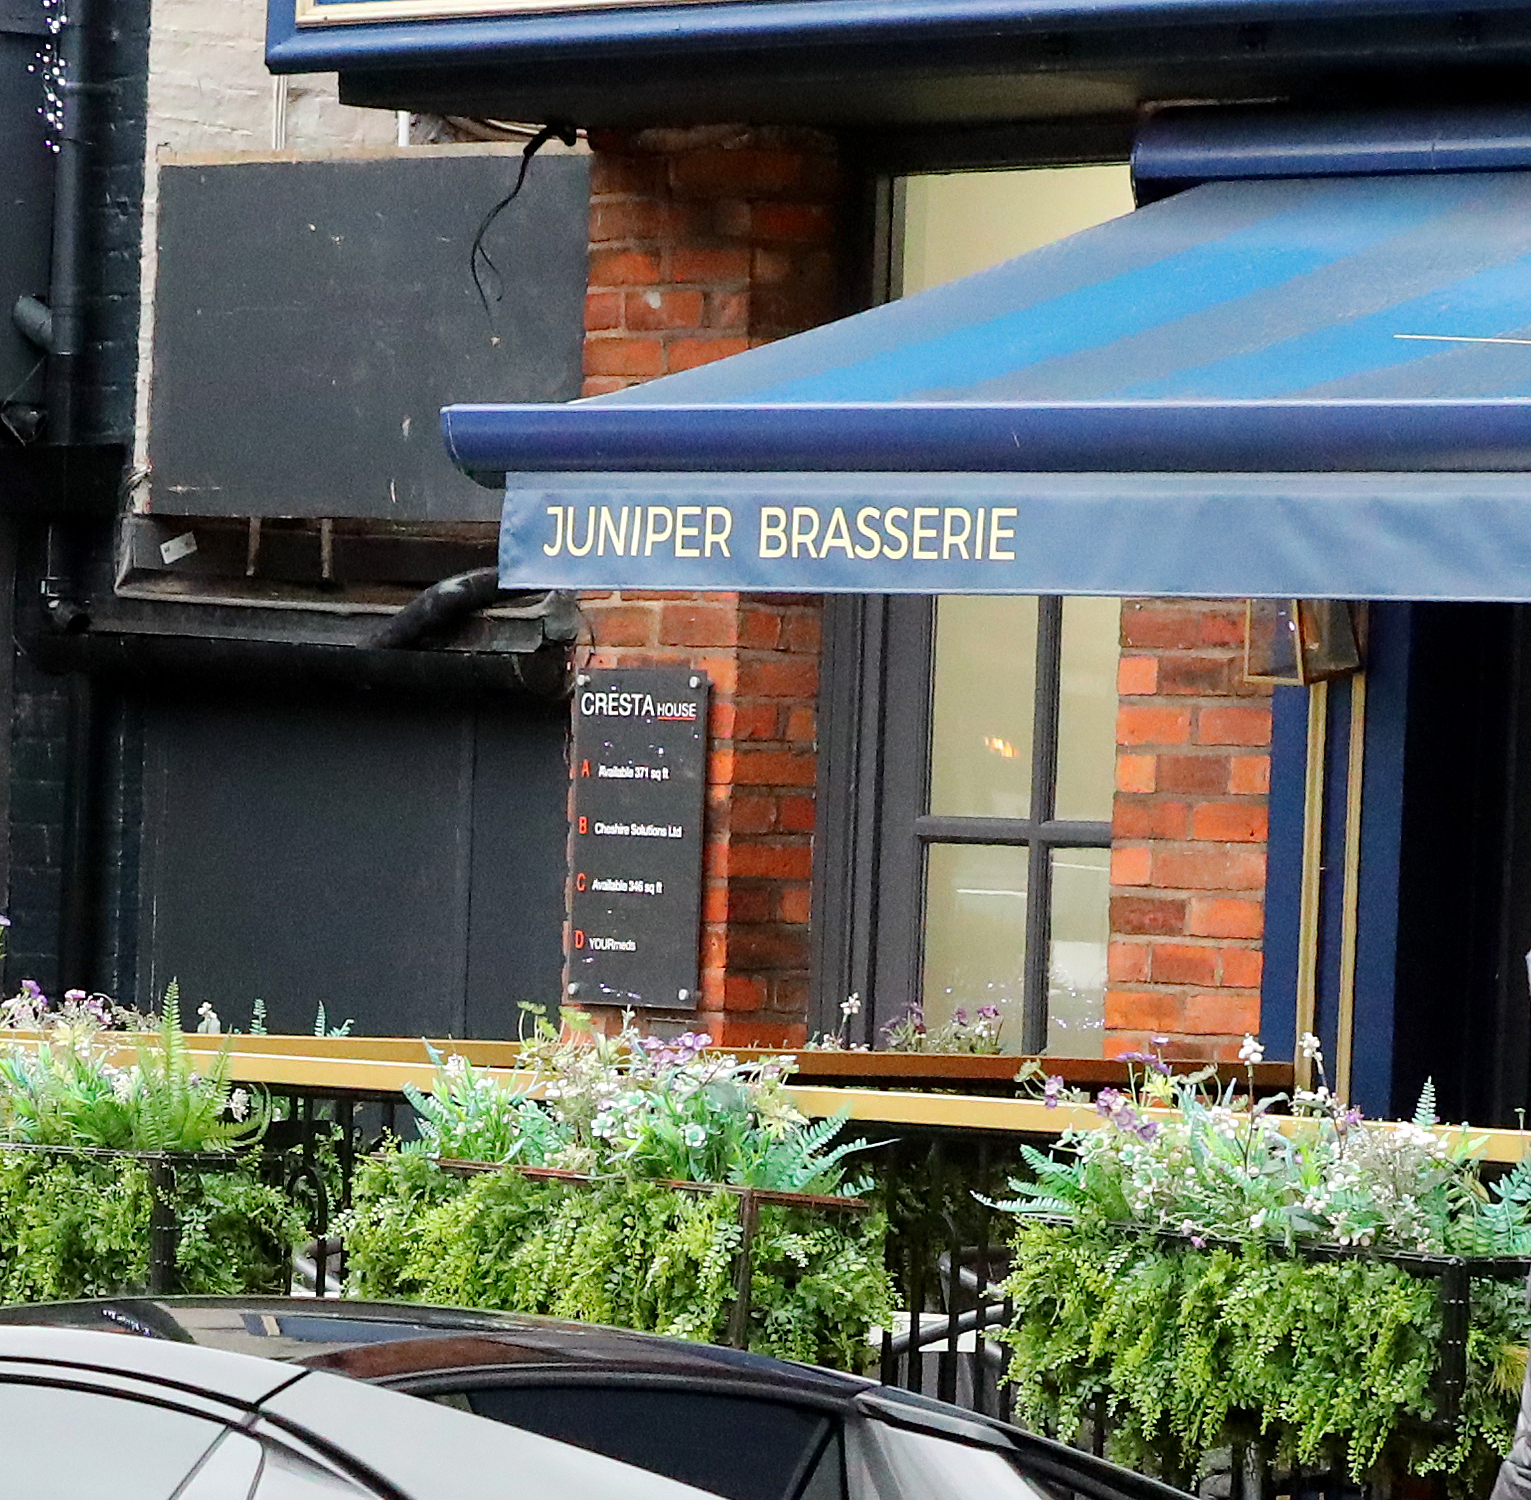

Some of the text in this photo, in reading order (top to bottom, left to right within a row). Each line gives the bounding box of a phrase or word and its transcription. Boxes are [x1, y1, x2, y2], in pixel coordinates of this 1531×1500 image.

[542, 505, 1018, 561] JUNIPER BRASSERIE
[581, 692, 697, 717] CRESTA HOUSE
[581, 759, 670, 781] A Available 371 sq ft
[578, 816, 682, 838] B Cheshire Solutions Ltd
[576, 873, 663, 895] C Available 346 sq ft
[574, 929, 637, 951] D YOURmeds
